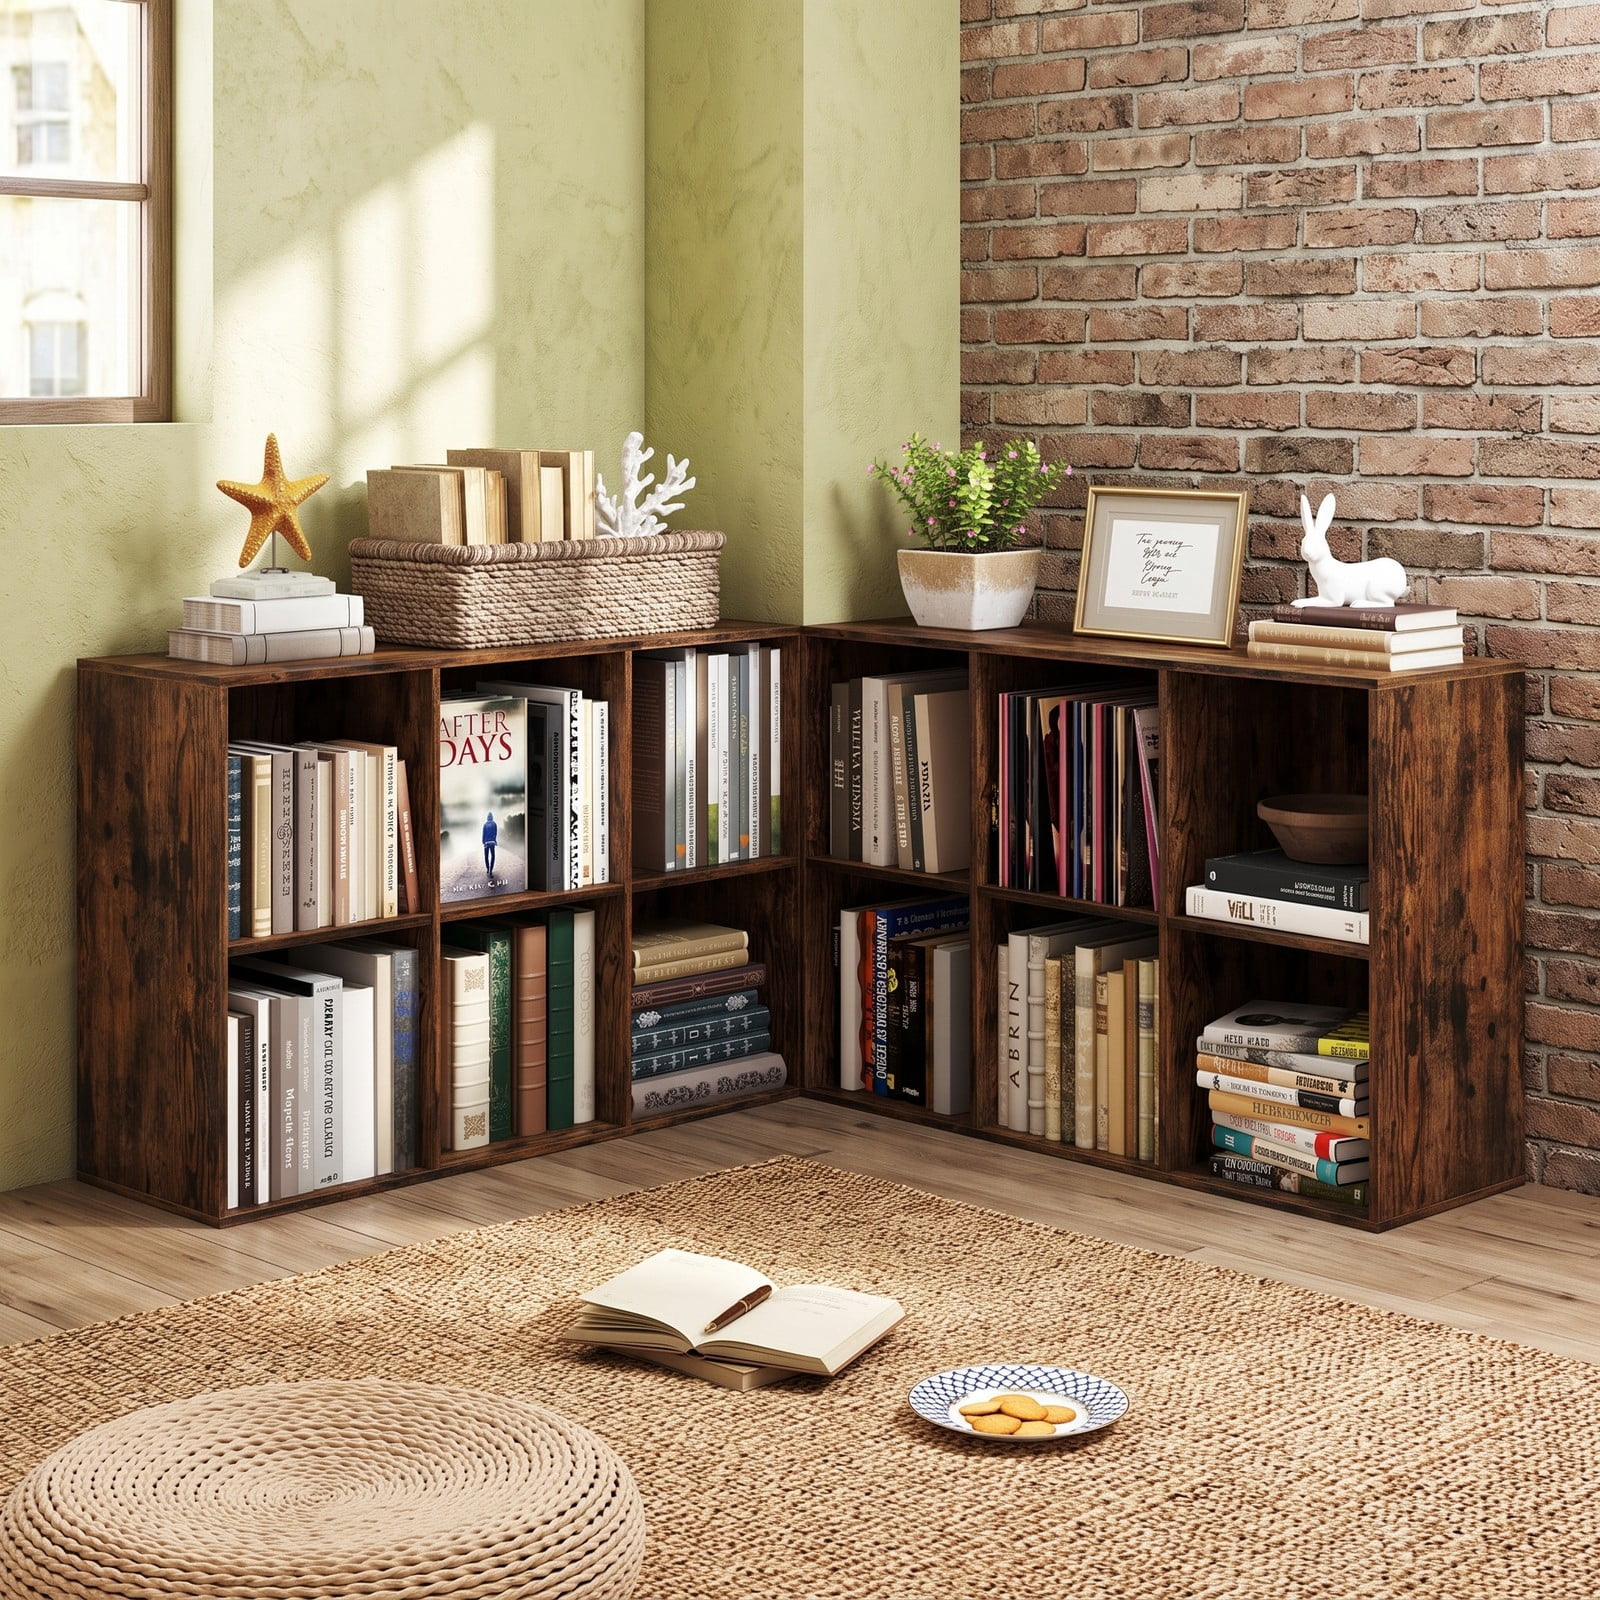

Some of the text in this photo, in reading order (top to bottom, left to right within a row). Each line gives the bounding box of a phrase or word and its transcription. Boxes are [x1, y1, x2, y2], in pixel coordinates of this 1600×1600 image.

[440, 711, 510, 738] AFTER
[440, 732, 512, 768] DAYS
[1009, 982, 1020, 1089] ABRIN
